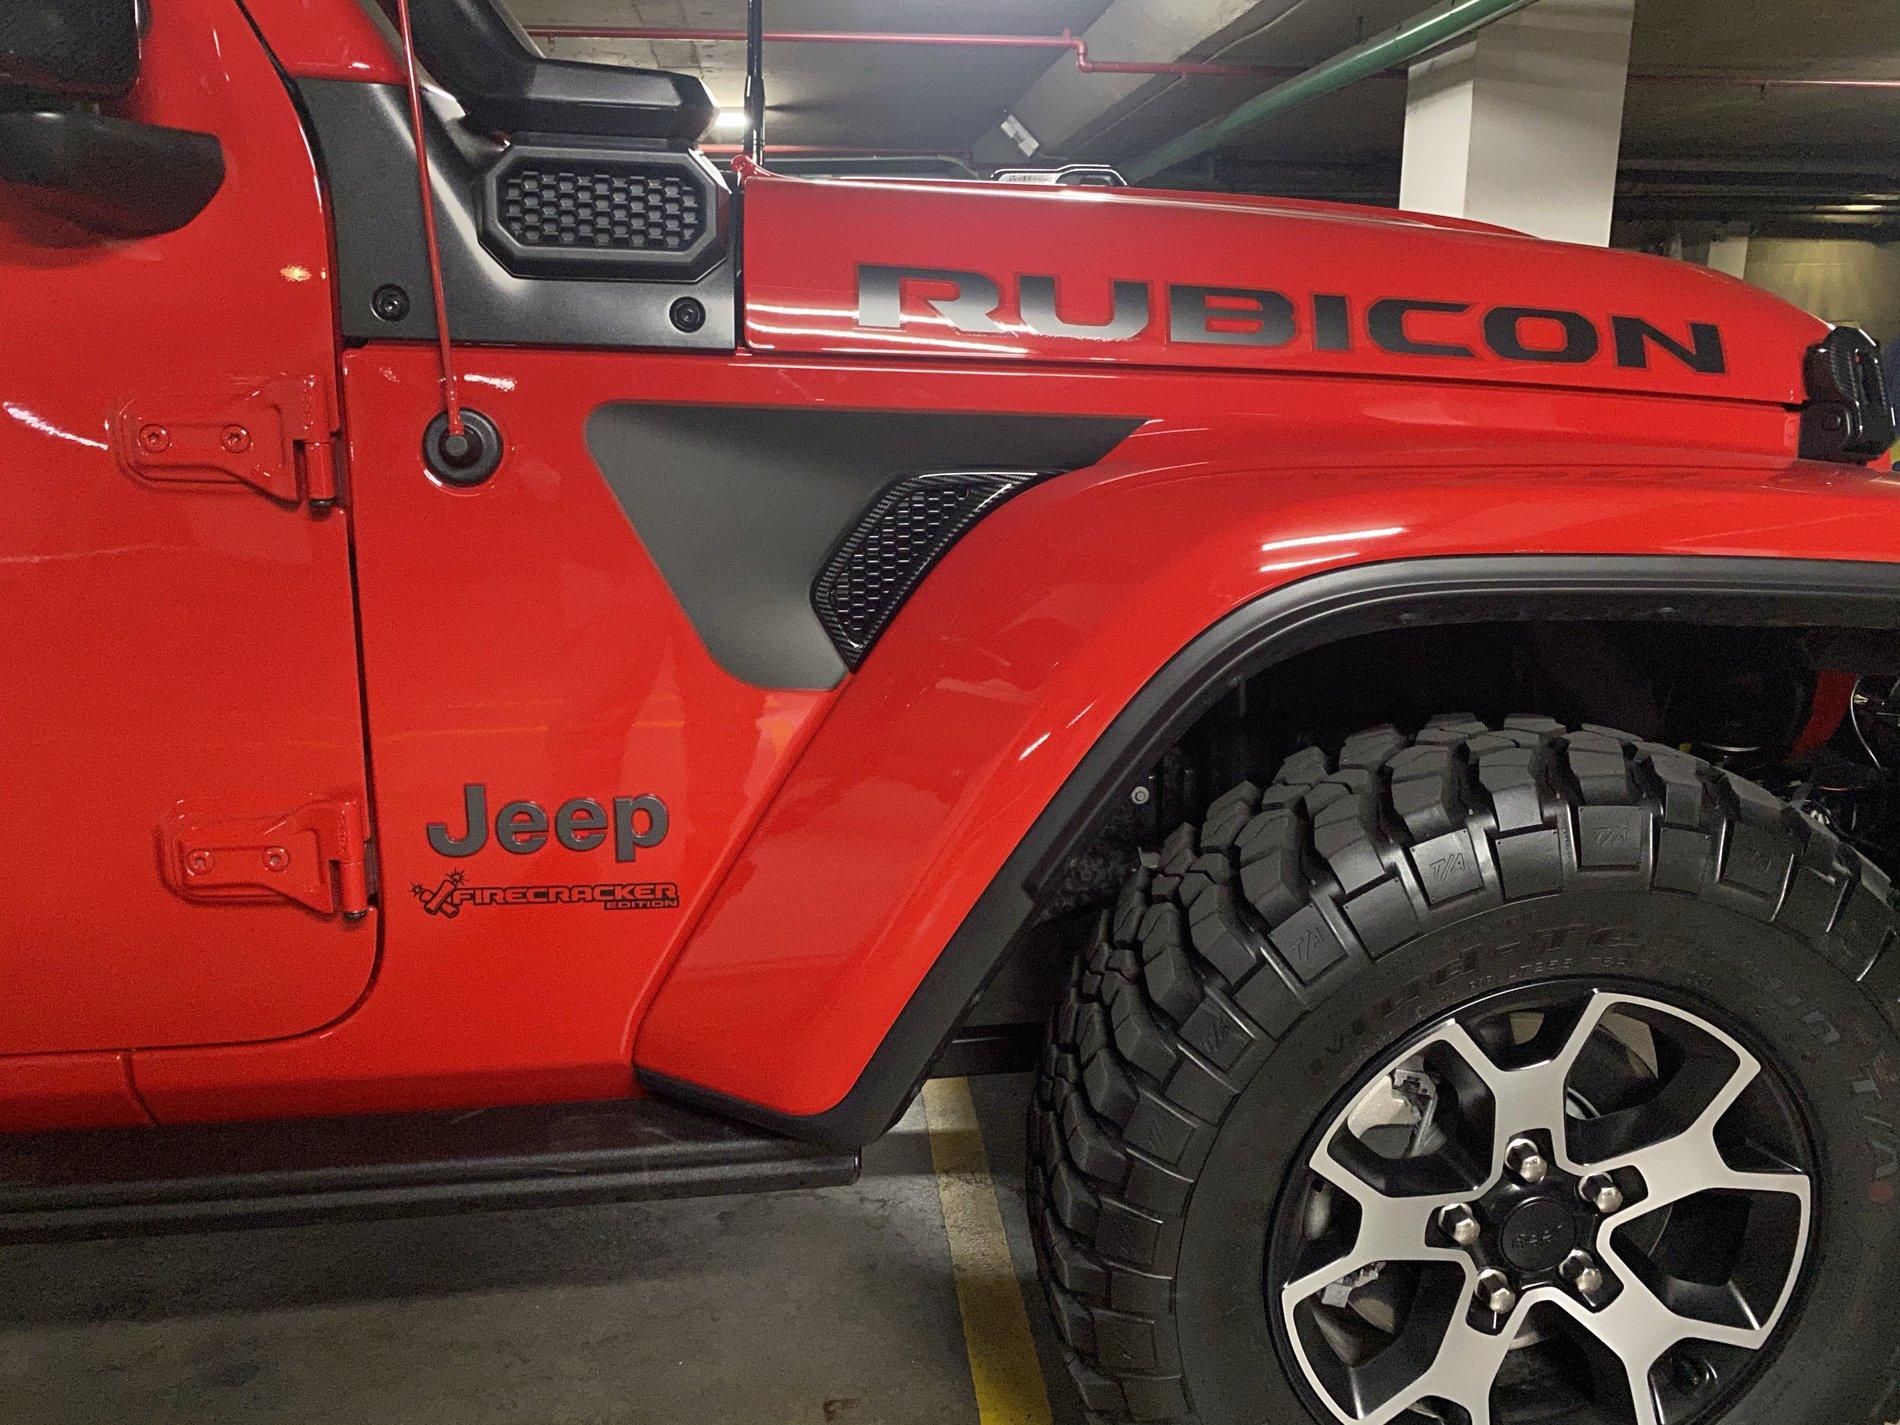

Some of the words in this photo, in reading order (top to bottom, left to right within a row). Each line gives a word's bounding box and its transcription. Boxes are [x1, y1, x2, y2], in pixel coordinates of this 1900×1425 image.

[853, 263, 1727, 376] RUBICON
[426, 783, 669, 863] Jeep
[1429, 850, 1467, 882] T/A
[453, 881, 680, 905] FIRECRACKER
[604, 898, 679, 910] EDITION
[1290, 925, 1326, 960] T/A
